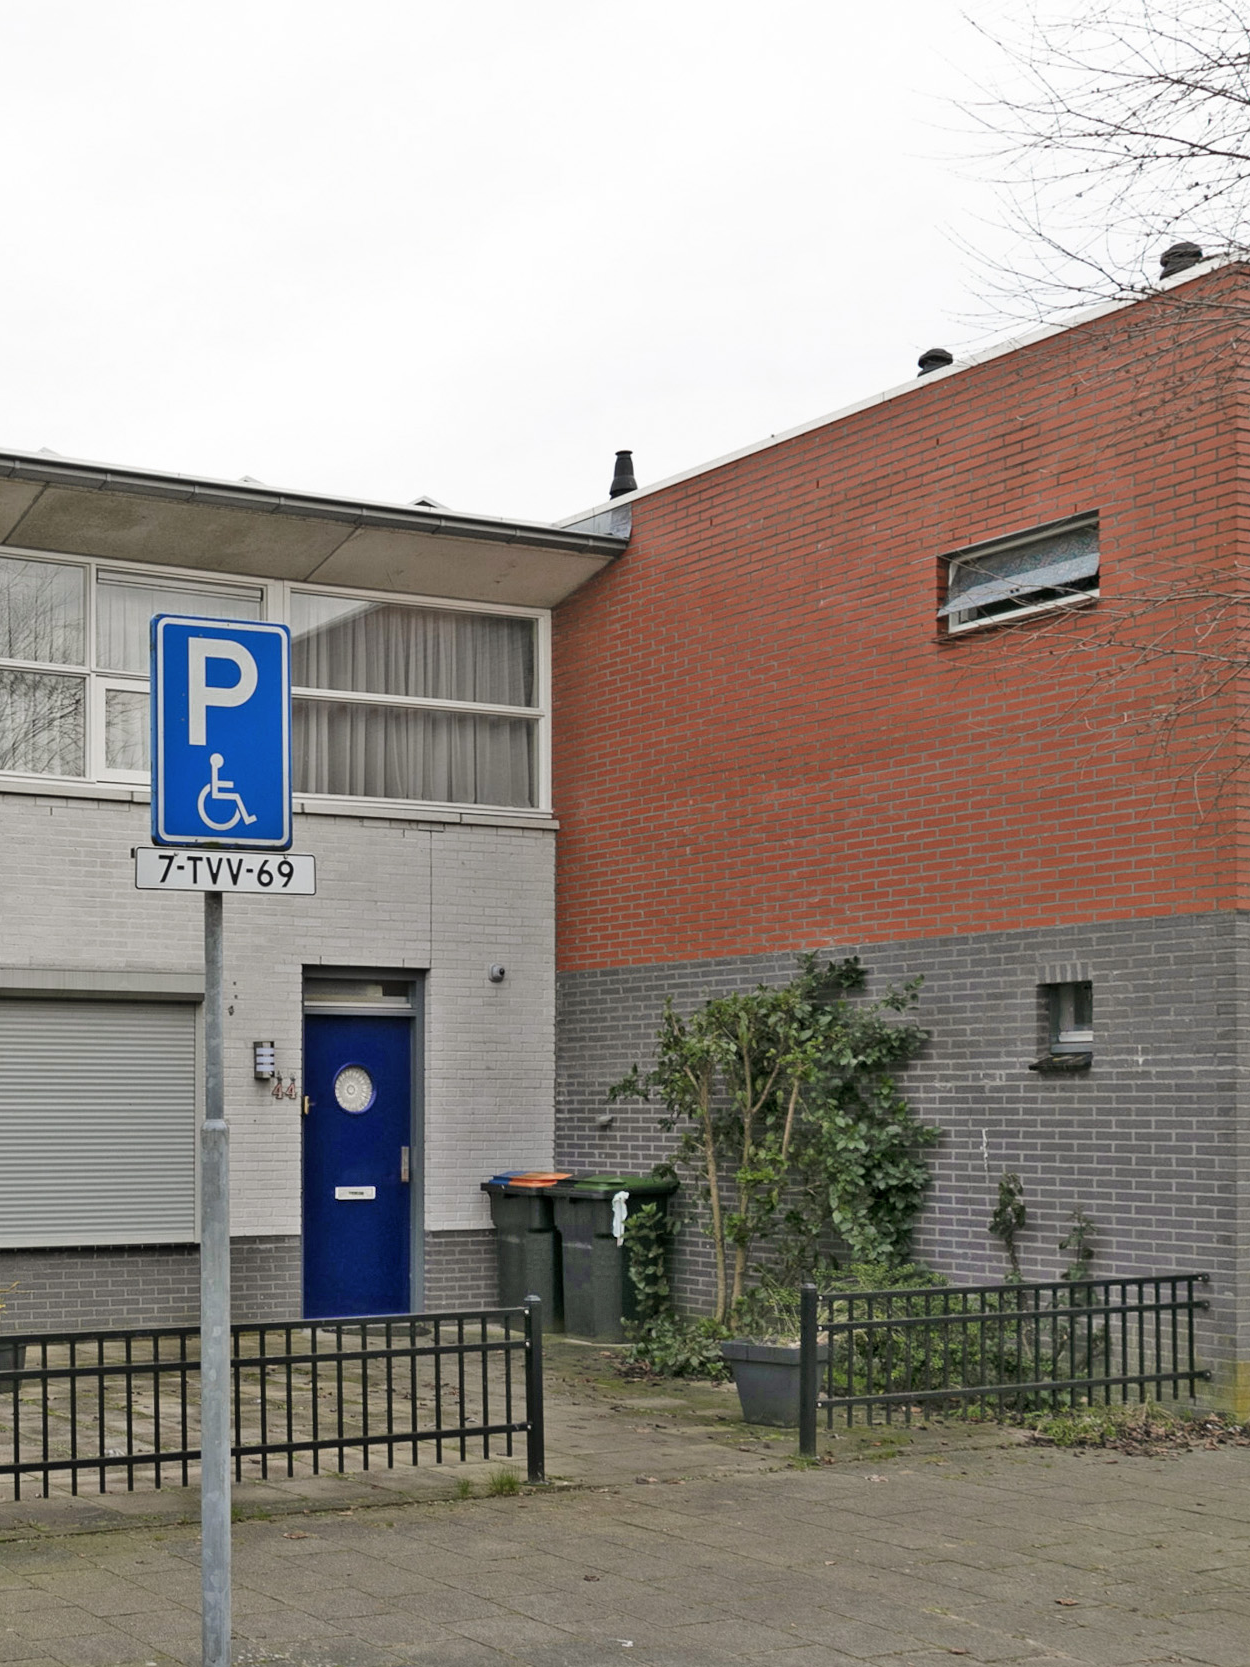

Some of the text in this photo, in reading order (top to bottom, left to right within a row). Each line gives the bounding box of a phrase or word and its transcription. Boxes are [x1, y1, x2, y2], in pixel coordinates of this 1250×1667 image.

[188, 636, 258, 746] P
[158, 854, 294, 888] 7-TVV-69
[272, 1082, 297, 1100] 44
